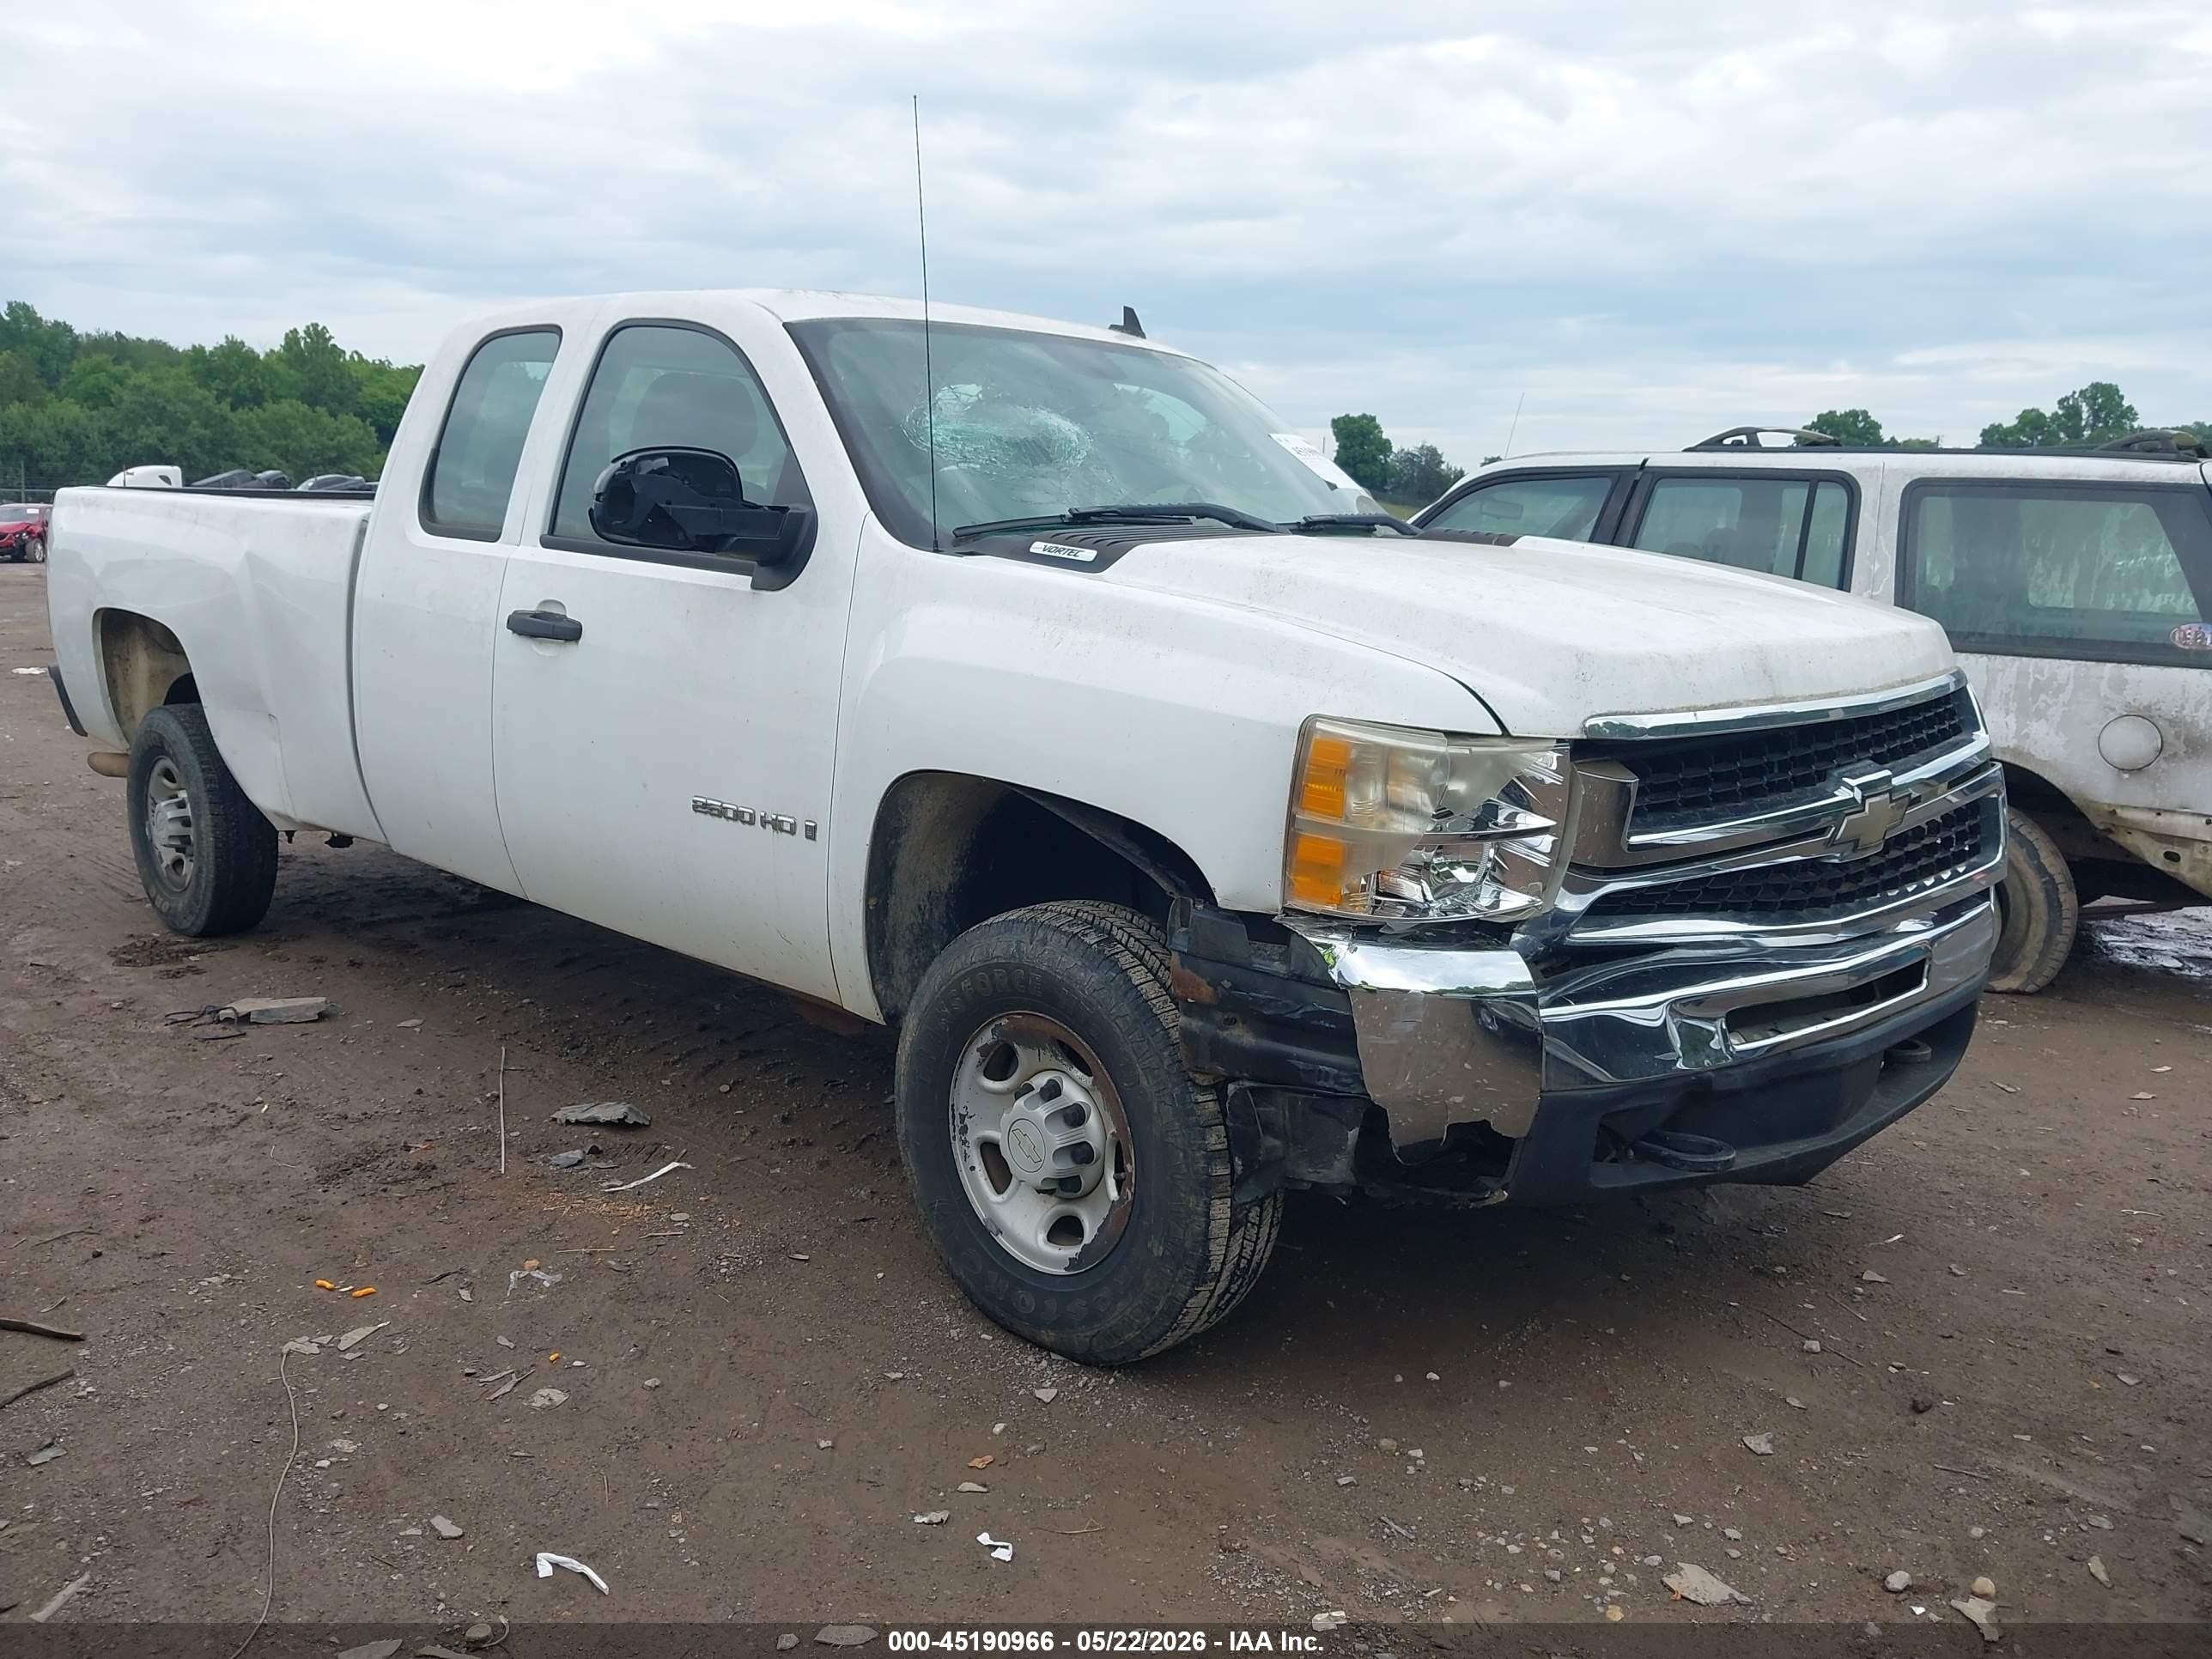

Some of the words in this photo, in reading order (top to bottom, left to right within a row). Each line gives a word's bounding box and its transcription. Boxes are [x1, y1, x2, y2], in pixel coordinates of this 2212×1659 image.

[1042, 544, 1086, 557] VORTEC
[691, 795, 756, 826] 2500
[760, 811, 797, 836] HD
